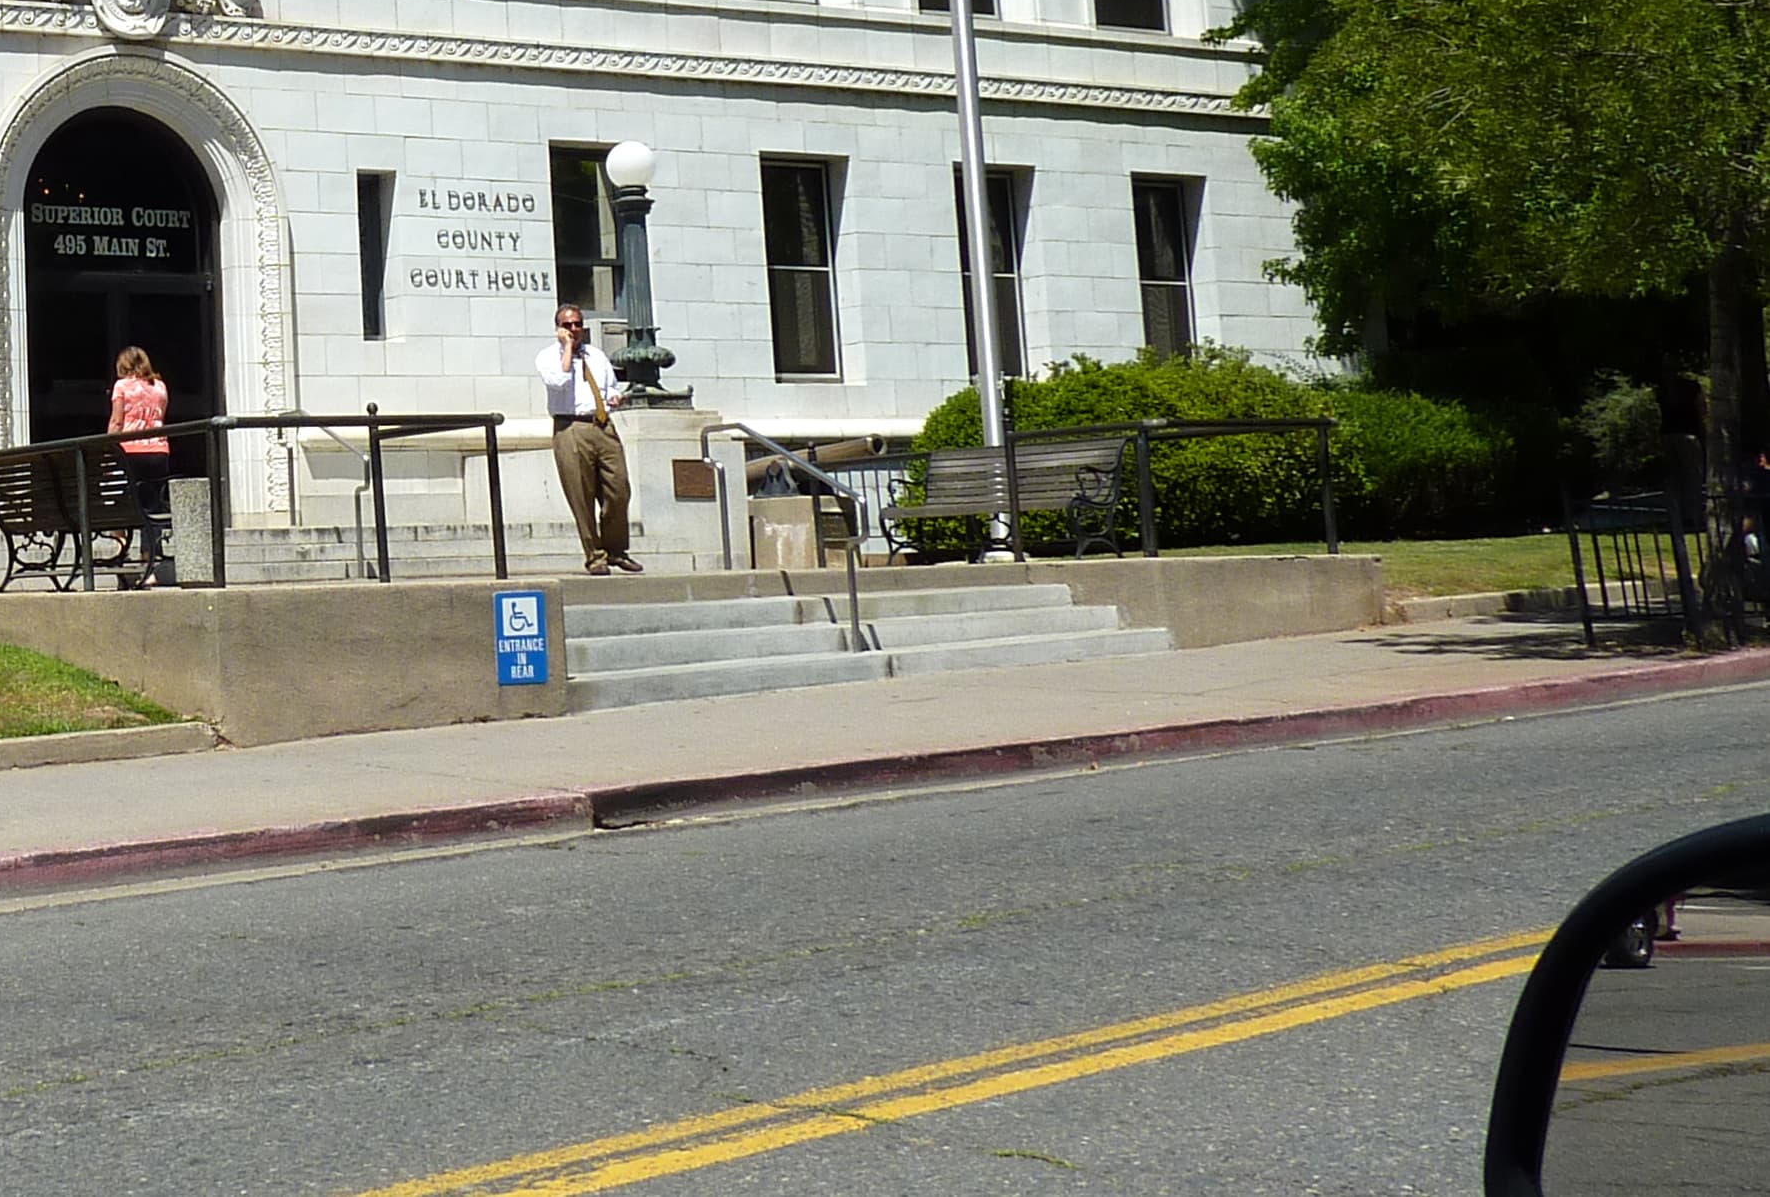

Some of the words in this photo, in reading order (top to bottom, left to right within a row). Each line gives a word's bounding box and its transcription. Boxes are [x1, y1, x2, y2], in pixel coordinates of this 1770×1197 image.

[419, 189, 441, 210] EL
[448, 191, 535, 213] DORADO
[32, 204, 125, 226] SUPERIOR
[131, 207, 191, 229] COURT
[54, 234, 87, 255] 495
[93, 236, 140, 257] MAIN
[145, 237, 170, 259] ST.
[437, 229, 520, 252] COUNTY
[410, 268, 480, 291] COURT
[487, 271, 551, 292] HOUSE
[498, 638, 544, 653] ENTRANCE
[517, 652, 527, 665] IN
[511, 665, 534, 679] REAR
